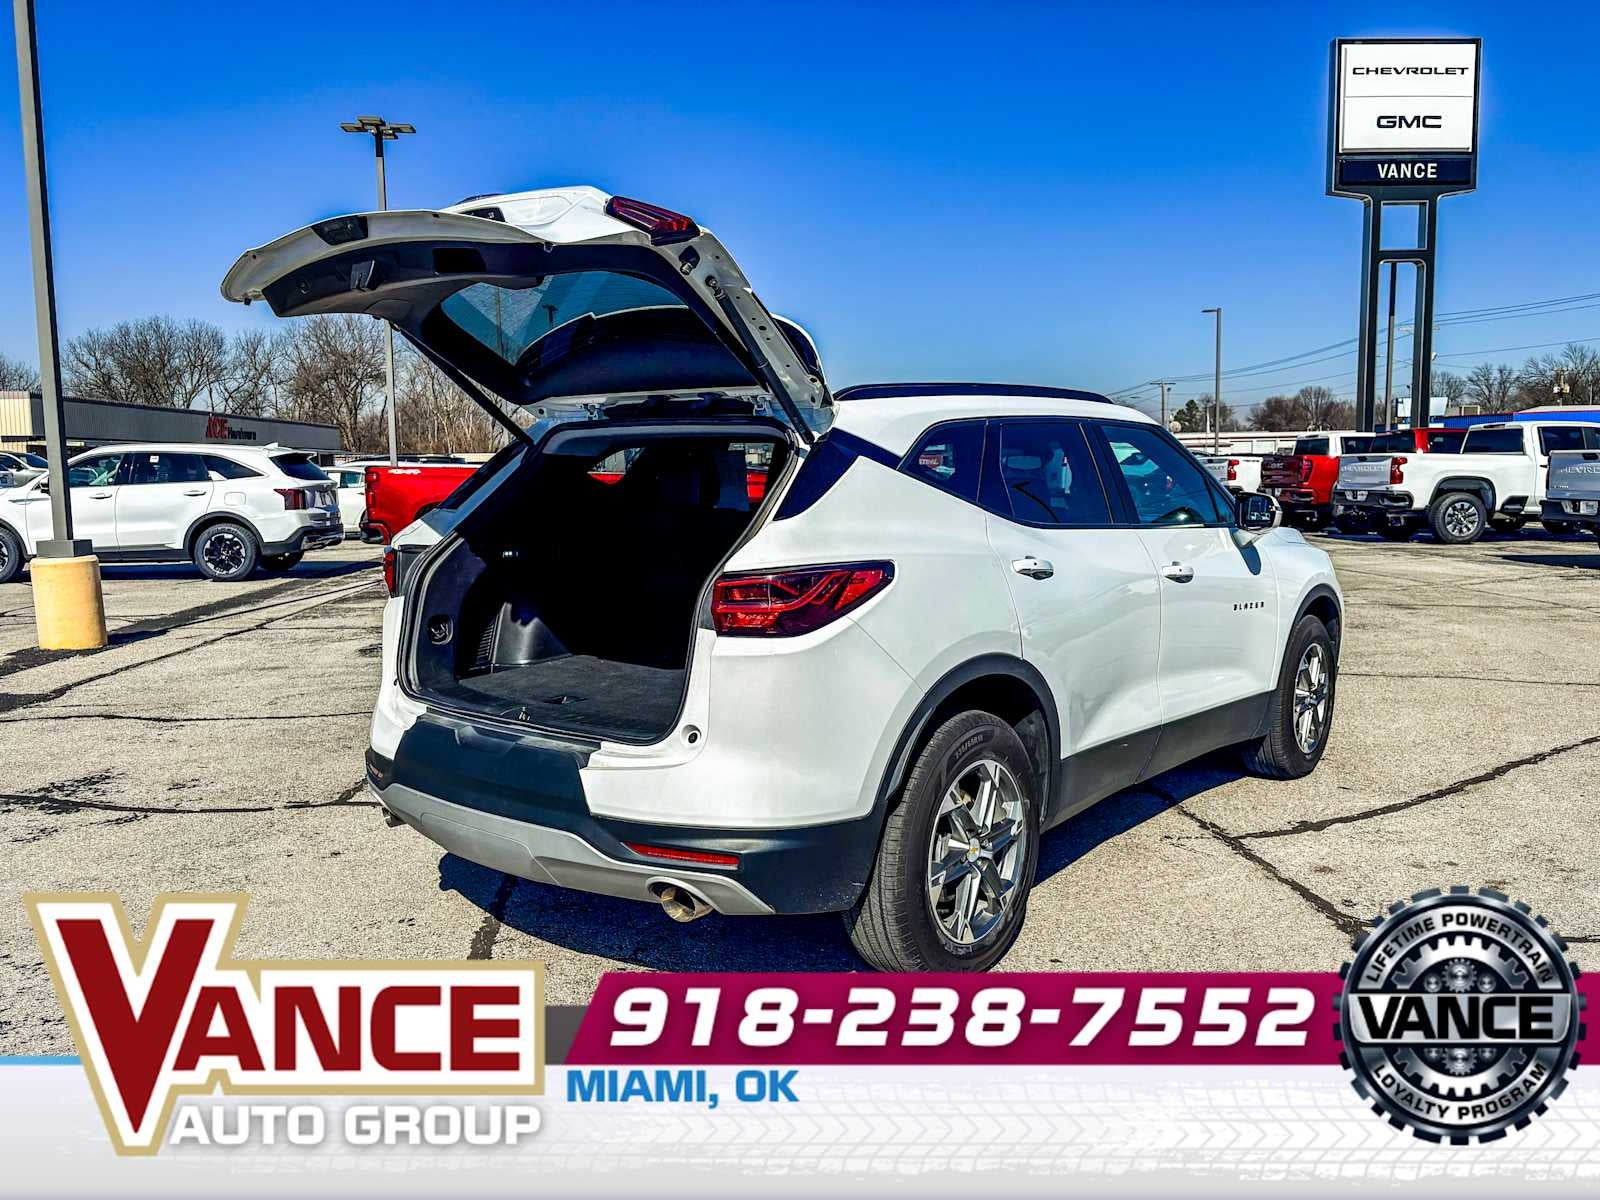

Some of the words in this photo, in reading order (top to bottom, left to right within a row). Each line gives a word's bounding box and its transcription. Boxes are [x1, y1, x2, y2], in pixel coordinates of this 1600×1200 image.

[1353, 67, 1469, 75] CHEVROLET
[1377, 115, 1442, 129] GMC
[1377, 163, 1438, 179] VANCE
[205, 416, 227, 438] ACE
[1340, 464, 1386, 473] CHEVROLET
[1233, 601, 1265, 611] BLAZER
